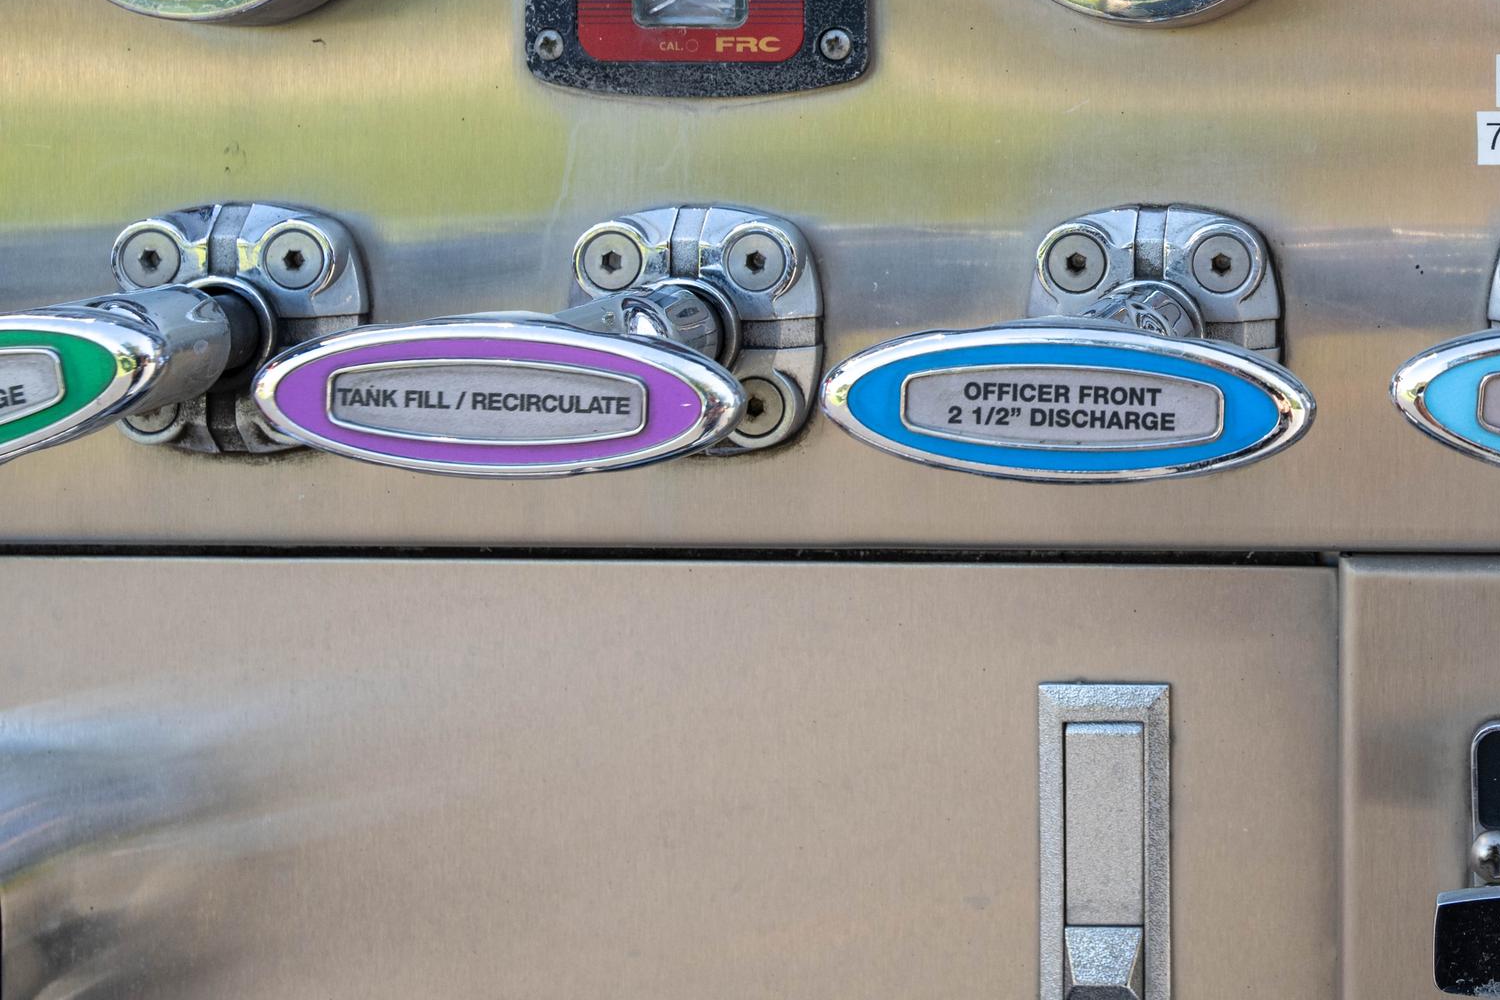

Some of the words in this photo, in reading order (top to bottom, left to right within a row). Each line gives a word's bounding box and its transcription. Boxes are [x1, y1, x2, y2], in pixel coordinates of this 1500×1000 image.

[659, 41, 684, 52] CAL.
[715, 36, 781, 53] FRC
[338, 386, 397, 409] TANK
[404, 388, 452, 410] FILL
[472, 392, 631, 416] RECIRCULATE
[963, 381, 1071, 404] OFFICER
[1079, 384, 1162, 407] FRONT
[947, 406, 963, 425] 2
[1029, 408, 1176, 432] DISCHARGE
